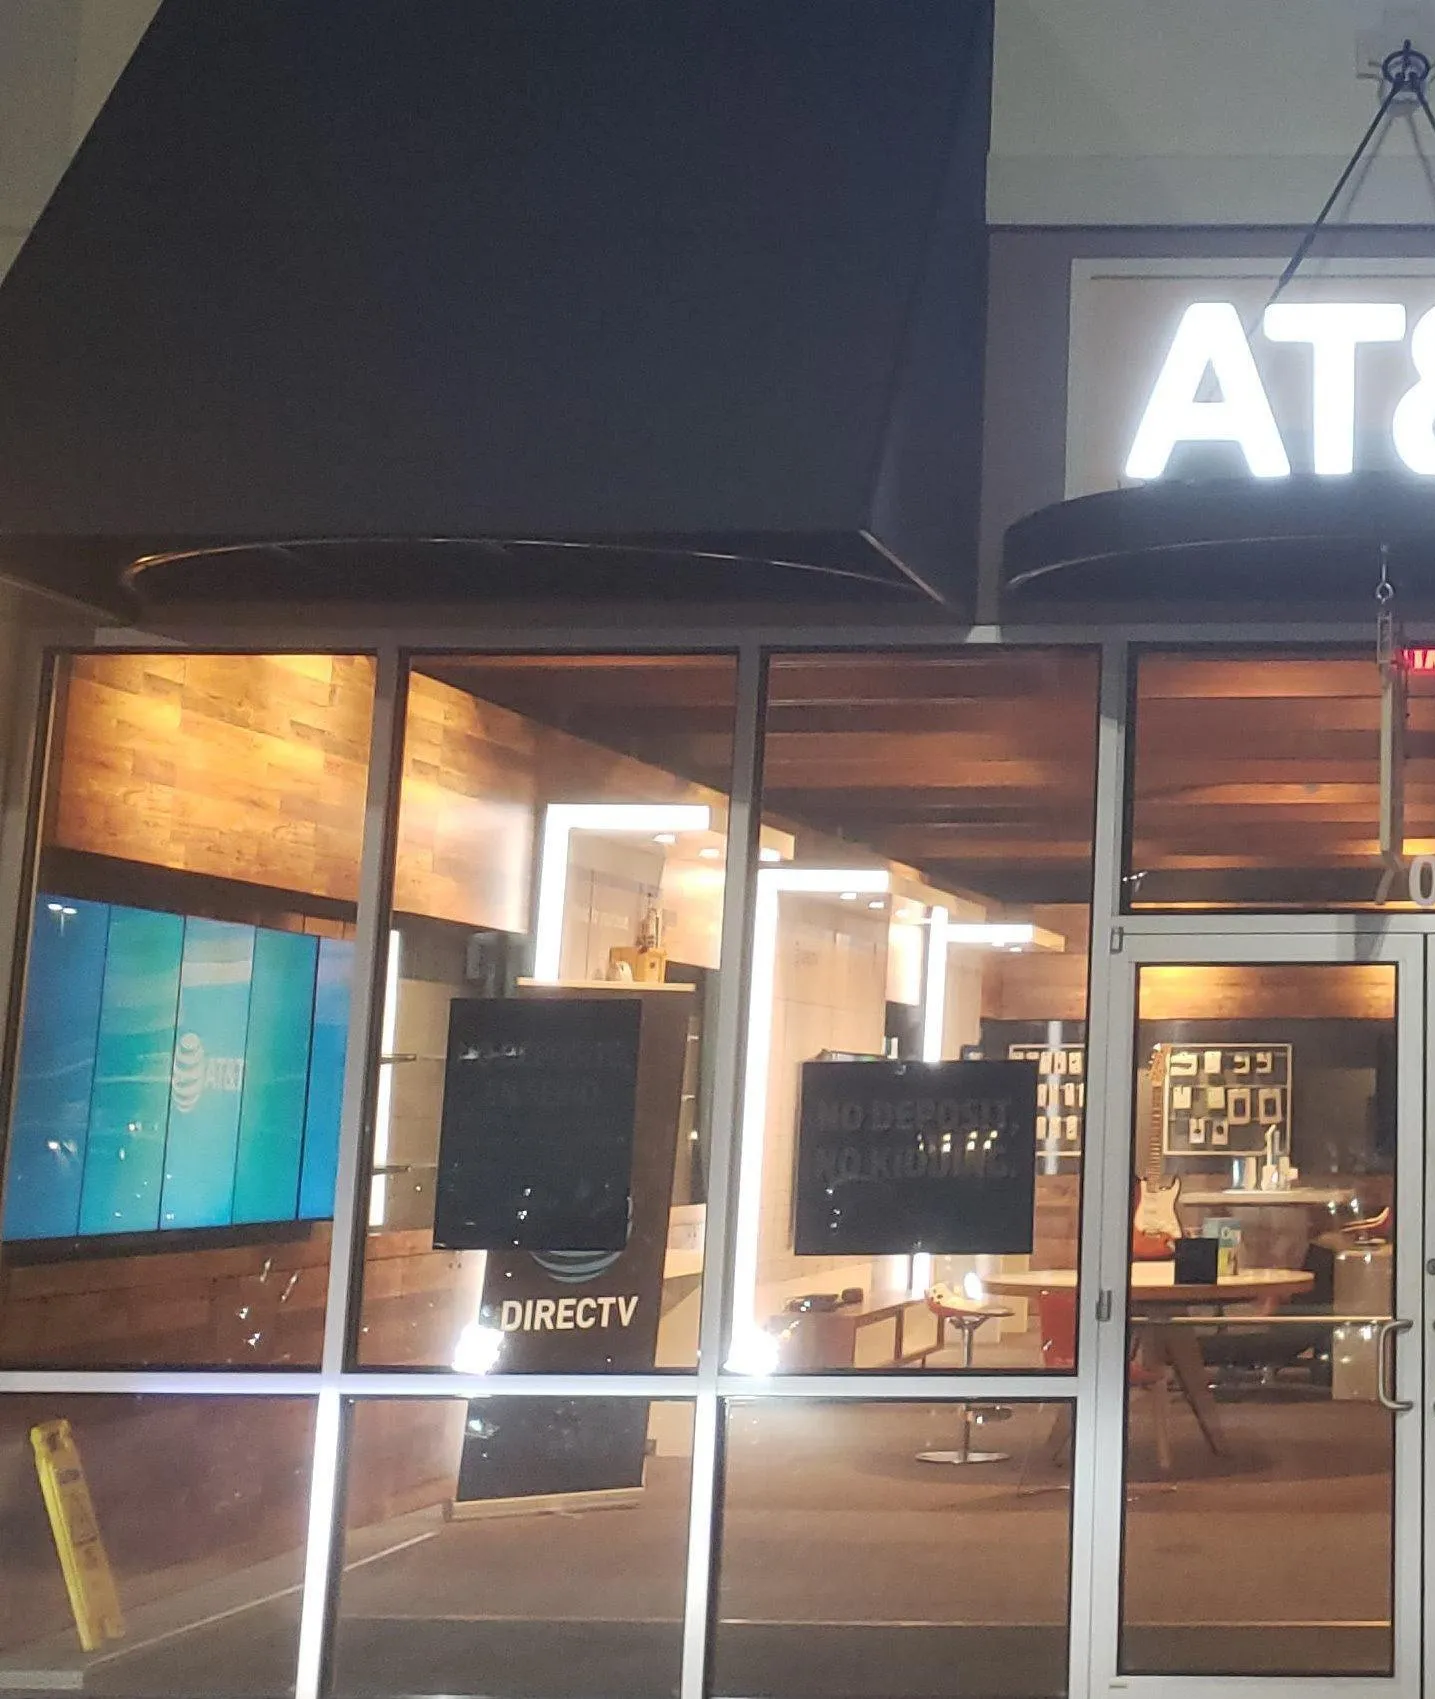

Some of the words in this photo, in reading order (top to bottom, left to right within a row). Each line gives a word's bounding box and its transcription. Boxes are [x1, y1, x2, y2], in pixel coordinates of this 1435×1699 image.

[815, 1099, 863, 1130] NO
[813, 1146, 862, 1178] NO
[500, 1296, 639, 1332] DIRECTV
